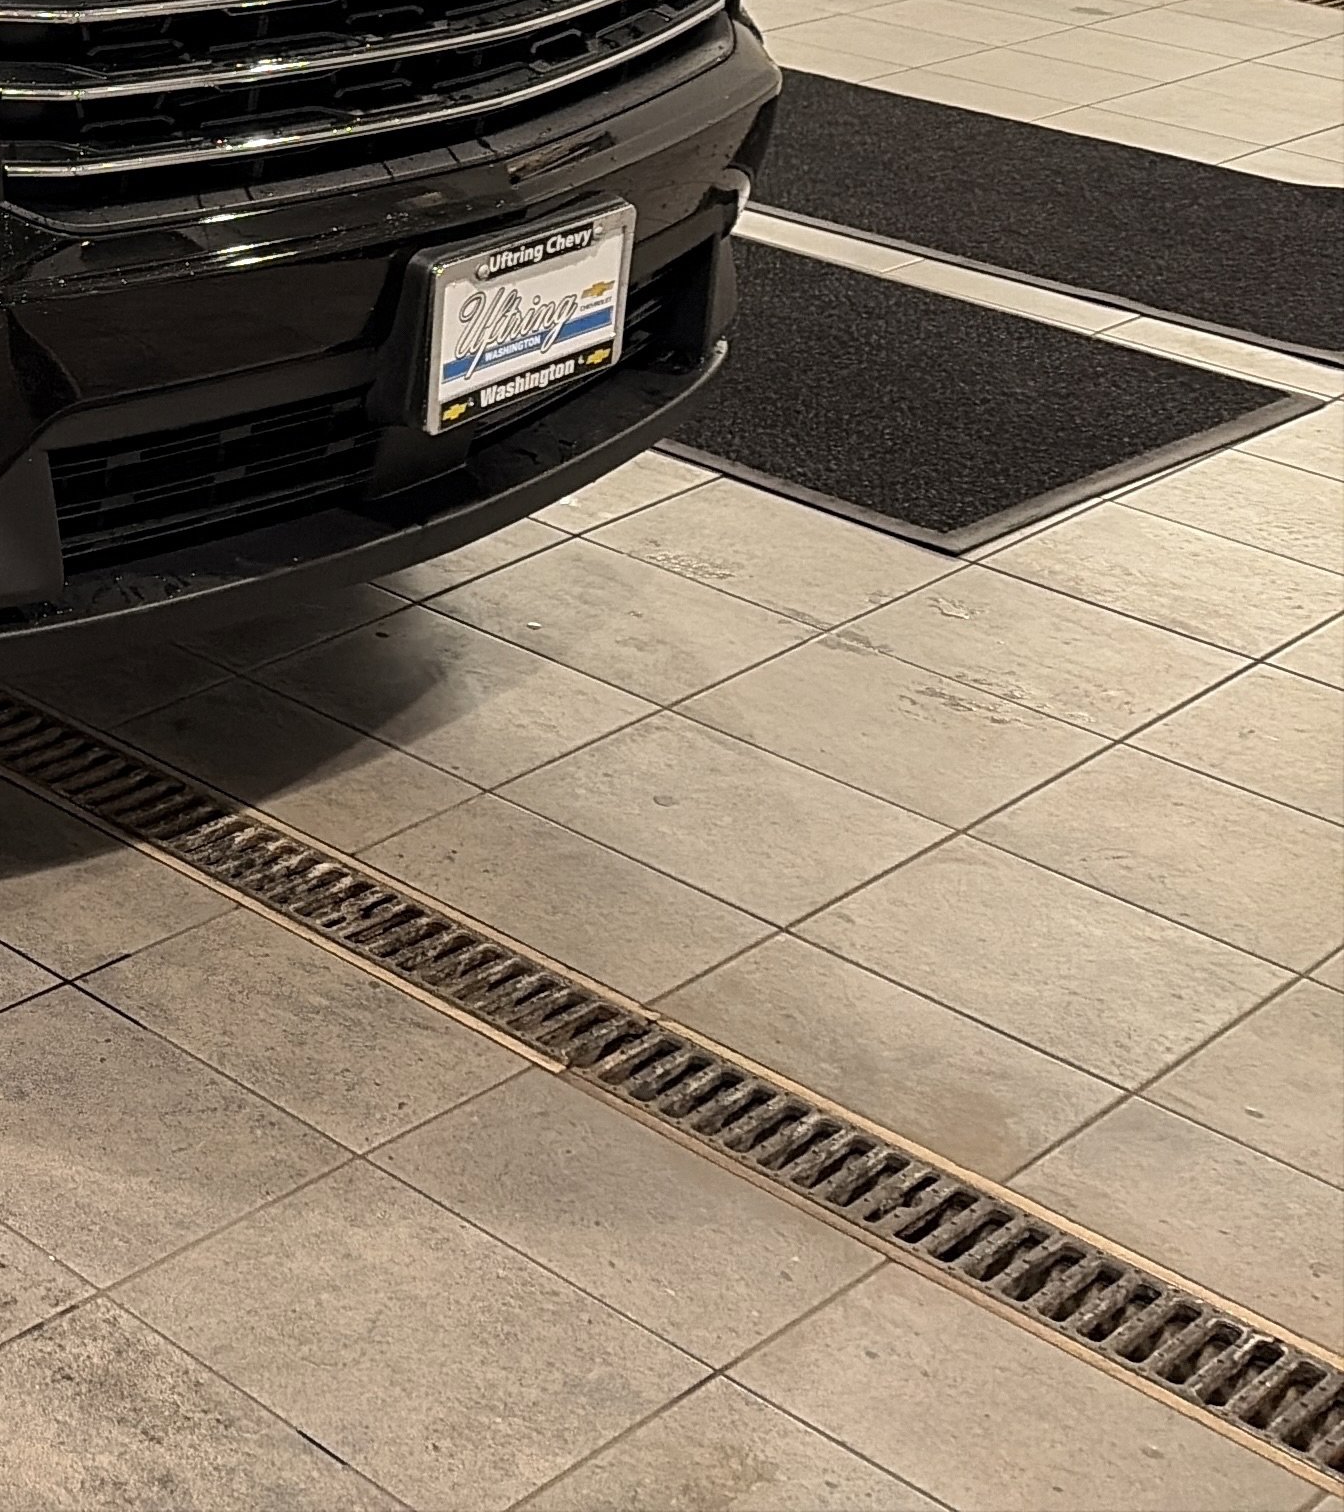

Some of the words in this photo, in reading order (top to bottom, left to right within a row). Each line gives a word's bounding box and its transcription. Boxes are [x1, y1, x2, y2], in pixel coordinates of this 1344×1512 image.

[489, 244, 544, 273] Uftring
[546, 228, 593, 254] Chevy
[579, 295, 613, 312] CHEVROLET
[484, 334, 542, 362] WASHINGTON
[480, 358, 575, 408] Washington
